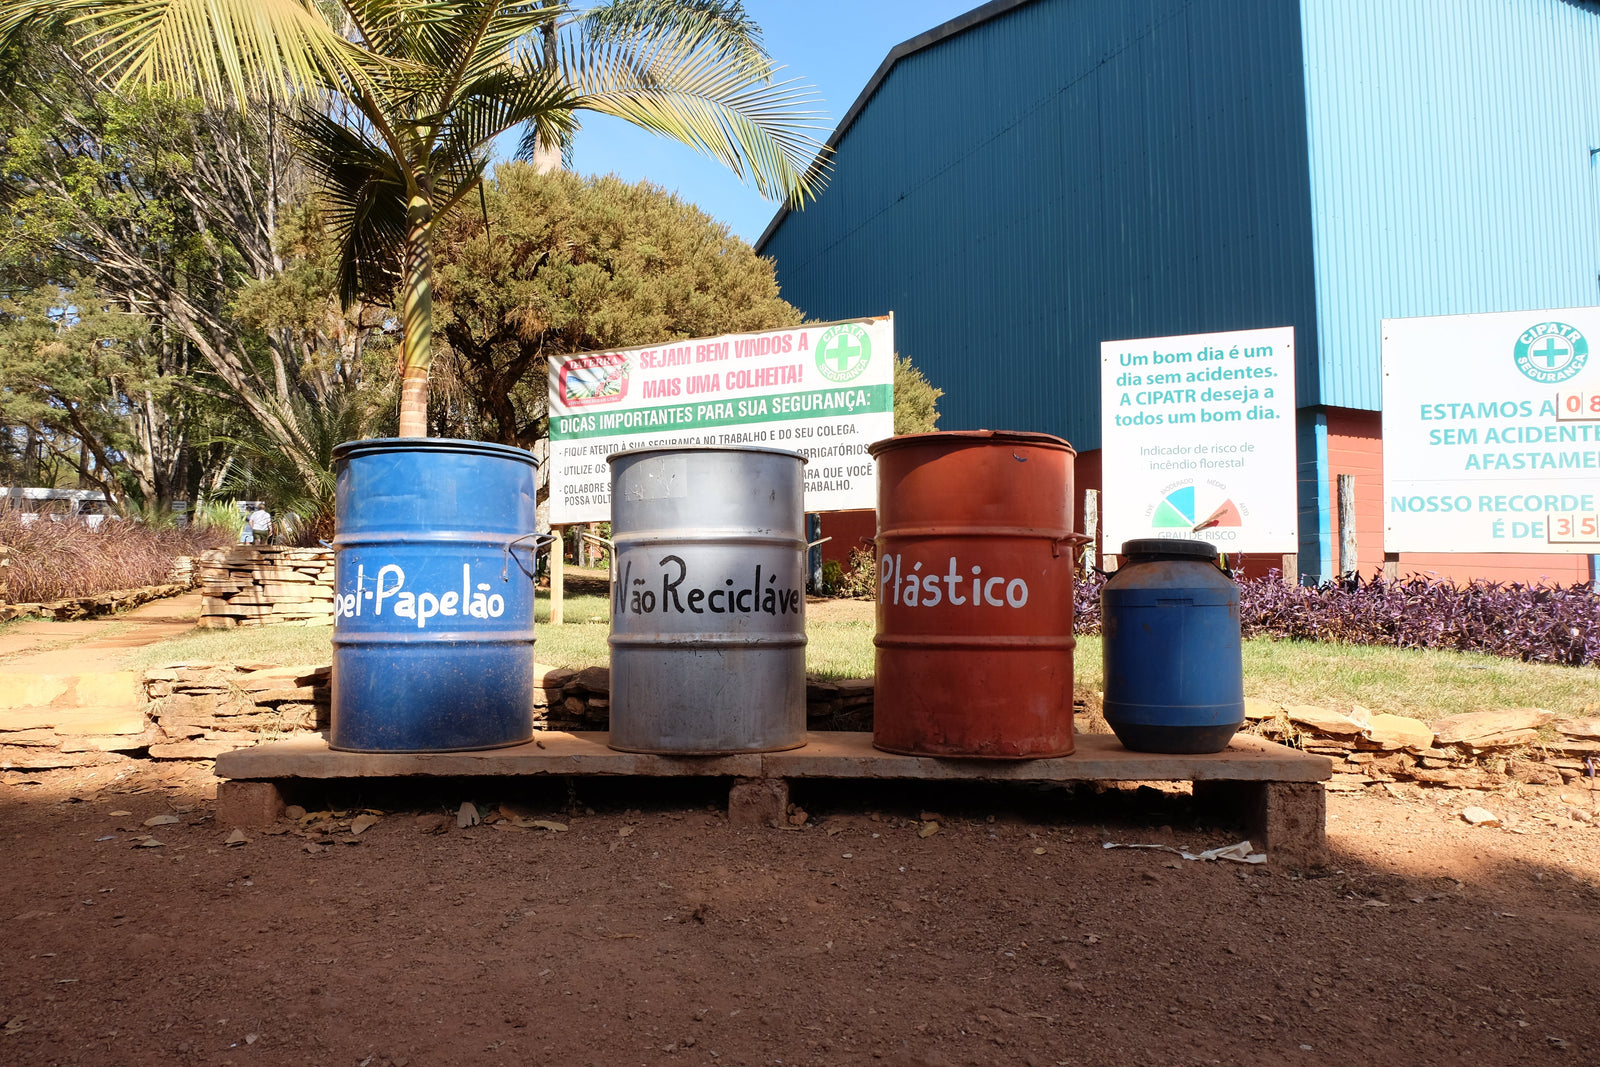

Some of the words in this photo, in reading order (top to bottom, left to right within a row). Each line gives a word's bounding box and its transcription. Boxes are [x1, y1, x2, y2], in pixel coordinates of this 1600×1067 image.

[823, 324, 865, 342] CIPATR
[1520, 323, 1582, 345] CIPATR
[640, 347, 691, 369] SEJAM
[696, 342, 729, 363] BEM
[734, 334, 792, 358] VINDOS
[798, 332, 808, 351] A
[1120, 353, 1148, 366] Um
[1153, 350, 1192, 364] bom
[1197, 347, 1224, 361] dia
[1229, 345, 1240, 359] é
[1244, 346, 1273, 358] um
[570, 356, 618, 369] DATERRA
[820, 358, 868, 382] SEGURANÇA
[1518, 353, 1588, 382] SEGURANÇA
[643, 378, 681, 398] MAIS
[686, 373, 721, 394] UMA
[726, 364, 803, 390] COLHEITA!
[1116, 372, 1142, 386] dia
[1146, 374, 1181, 384] sem
[1186, 366, 1278, 382] acidentes.
[1120, 393, 1131, 406] A
[1136, 389, 1196, 405] CIPATR
[1200, 386, 1259, 404] deseja
[1264, 388, 1274, 398] a
[560, 416, 596, 434] DICAS
[600, 406, 692, 430] IMPORTANTES
[698, 402, 734, 420] PARA
[738, 399, 768, 417] SUA
[772, 390, 870, 414] SEGURANÇA:
[1115, 411, 1164, 426] todos
[1168, 412, 1196, 424] um
[1201, 408, 1242, 422] bom
[1246, 406, 1280, 420] dia.
[1420, 401, 1532, 420] ESTAMOS
[1539, 400, 1556, 416] A
[564, 446, 587, 456] FIQUE
[590, 444, 618, 455] ATENTO
[704, 436, 716, 446] NO
[719, 430, 767, 445] TRABALHO
[770, 430, 775, 440] E
[778, 428, 792, 440] DO
[795, 426, 814, 438] SEU
[817, 424, 859, 436] COLEGA.
[1429, 428, 1478, 445] SEM
[1140, 445, 1191, 456] Indicador
[1194, 444, 1208, 454] de
[1212, 444, 1237, 454] risco
[1240, 442, 1254, 452] de
[564, 464, 592, 476] UTILIZE
[595, 464, 606, 474] OS
[1150, 460, 1197, 470] incêndio
[1200, 458, 1244, 468] florestal
[1465, 451, 1600, 470] AFASTAME
[564, 482, 604, 494] COLABORE
[803, 468, 820, 480] ARA
[823, 466, 843, 478] QUE
[847, 462, 872, 476] VOCÊ
[565, 496, 590, 506] POSSA
[804, 480, 854, 492] RABALHO.
[1391, 496, 1472, 513] NOSSO
[1478, 494, 1594, 512] RECORDE
[1158, 532, 1186, 540] GRAU
[1206, 531, 1236, 540] RISCO
[1492, 518, 1505, 538] É
[1512, 521, 1544, 538] DE
[614, 560, 656, 615] Não
[880, 554, 1028, 608] Plástico
